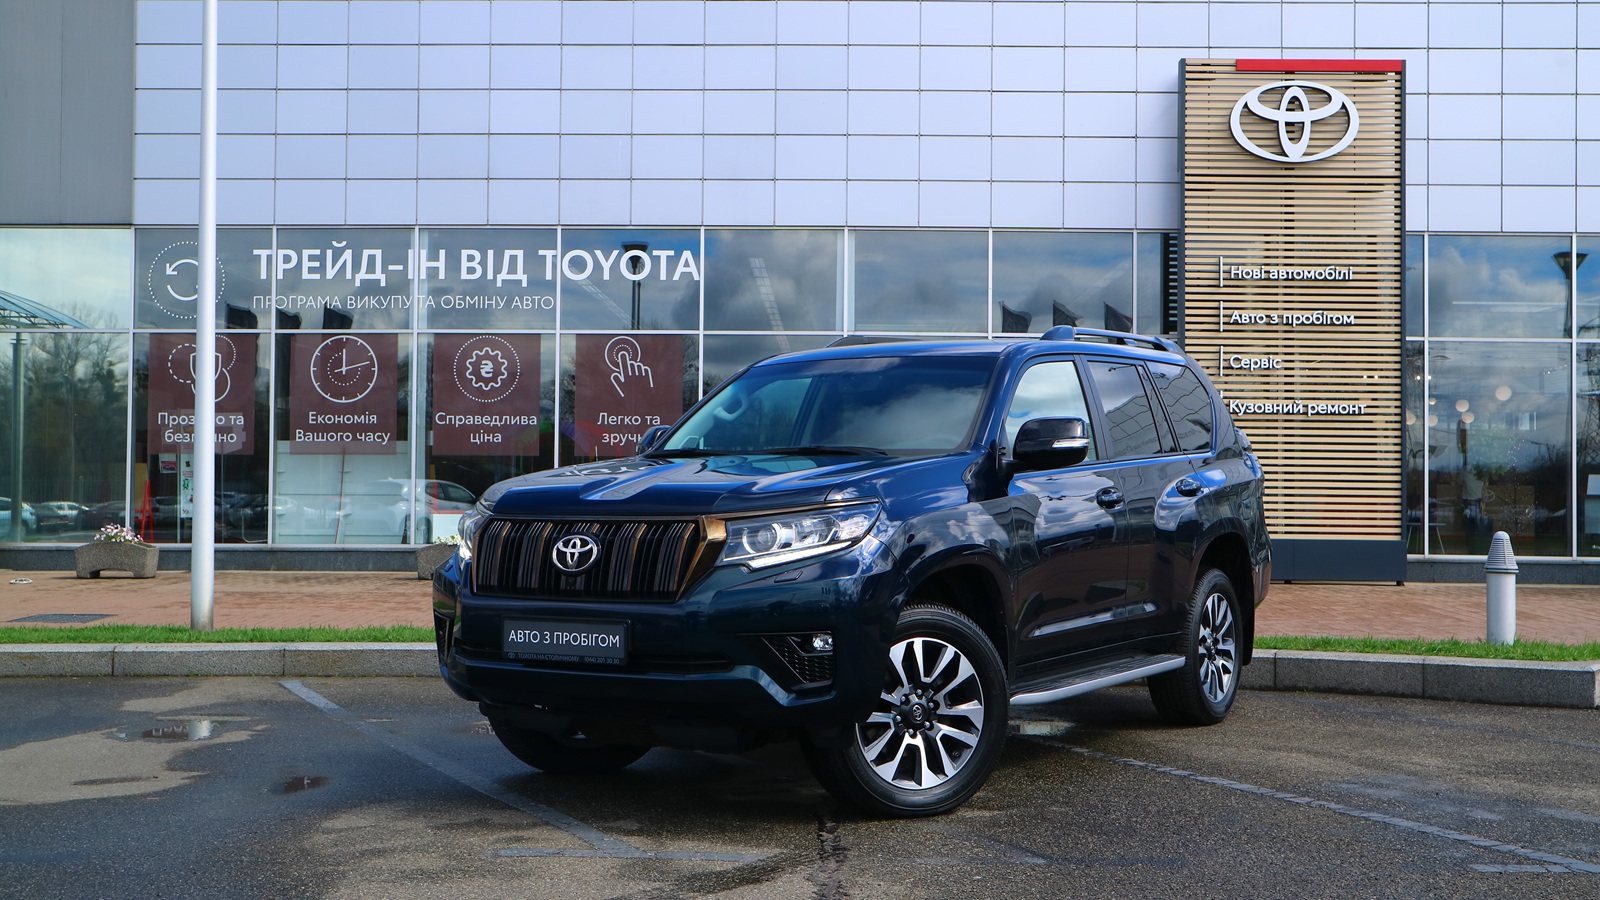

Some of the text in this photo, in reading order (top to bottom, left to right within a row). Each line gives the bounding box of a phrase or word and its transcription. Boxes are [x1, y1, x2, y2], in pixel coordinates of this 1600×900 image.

[253, 240, 700, 287] ТРЕЙД-ІН ВІД TOYOTA
[1230, 265, 1353, 280] Нові автомобілі
[253, 295, 554, 310] ПРОГРАМА ВИКУПУ ТА ОБМІНУ АВТО
[1230, 310, 1355, 328] Авто з пробігом
[1229, 355, 1282, 371] Сервіс
[1229, 399, 1367, 417] Кузовний ремонт
[157, 412, 244, 428] Прозо та
[308, 411, 377, 424] Економія
[435, 412, 537, 428] Справедлива
[597, 412, 660, 425] Легко та
[295, 429, 390, 445] Вашого часу
[470, 429, 502, 444] ціна
[508, 629, 540, 643] АВТО
[553, 632, 620, 647] ПРОБІГОМ
